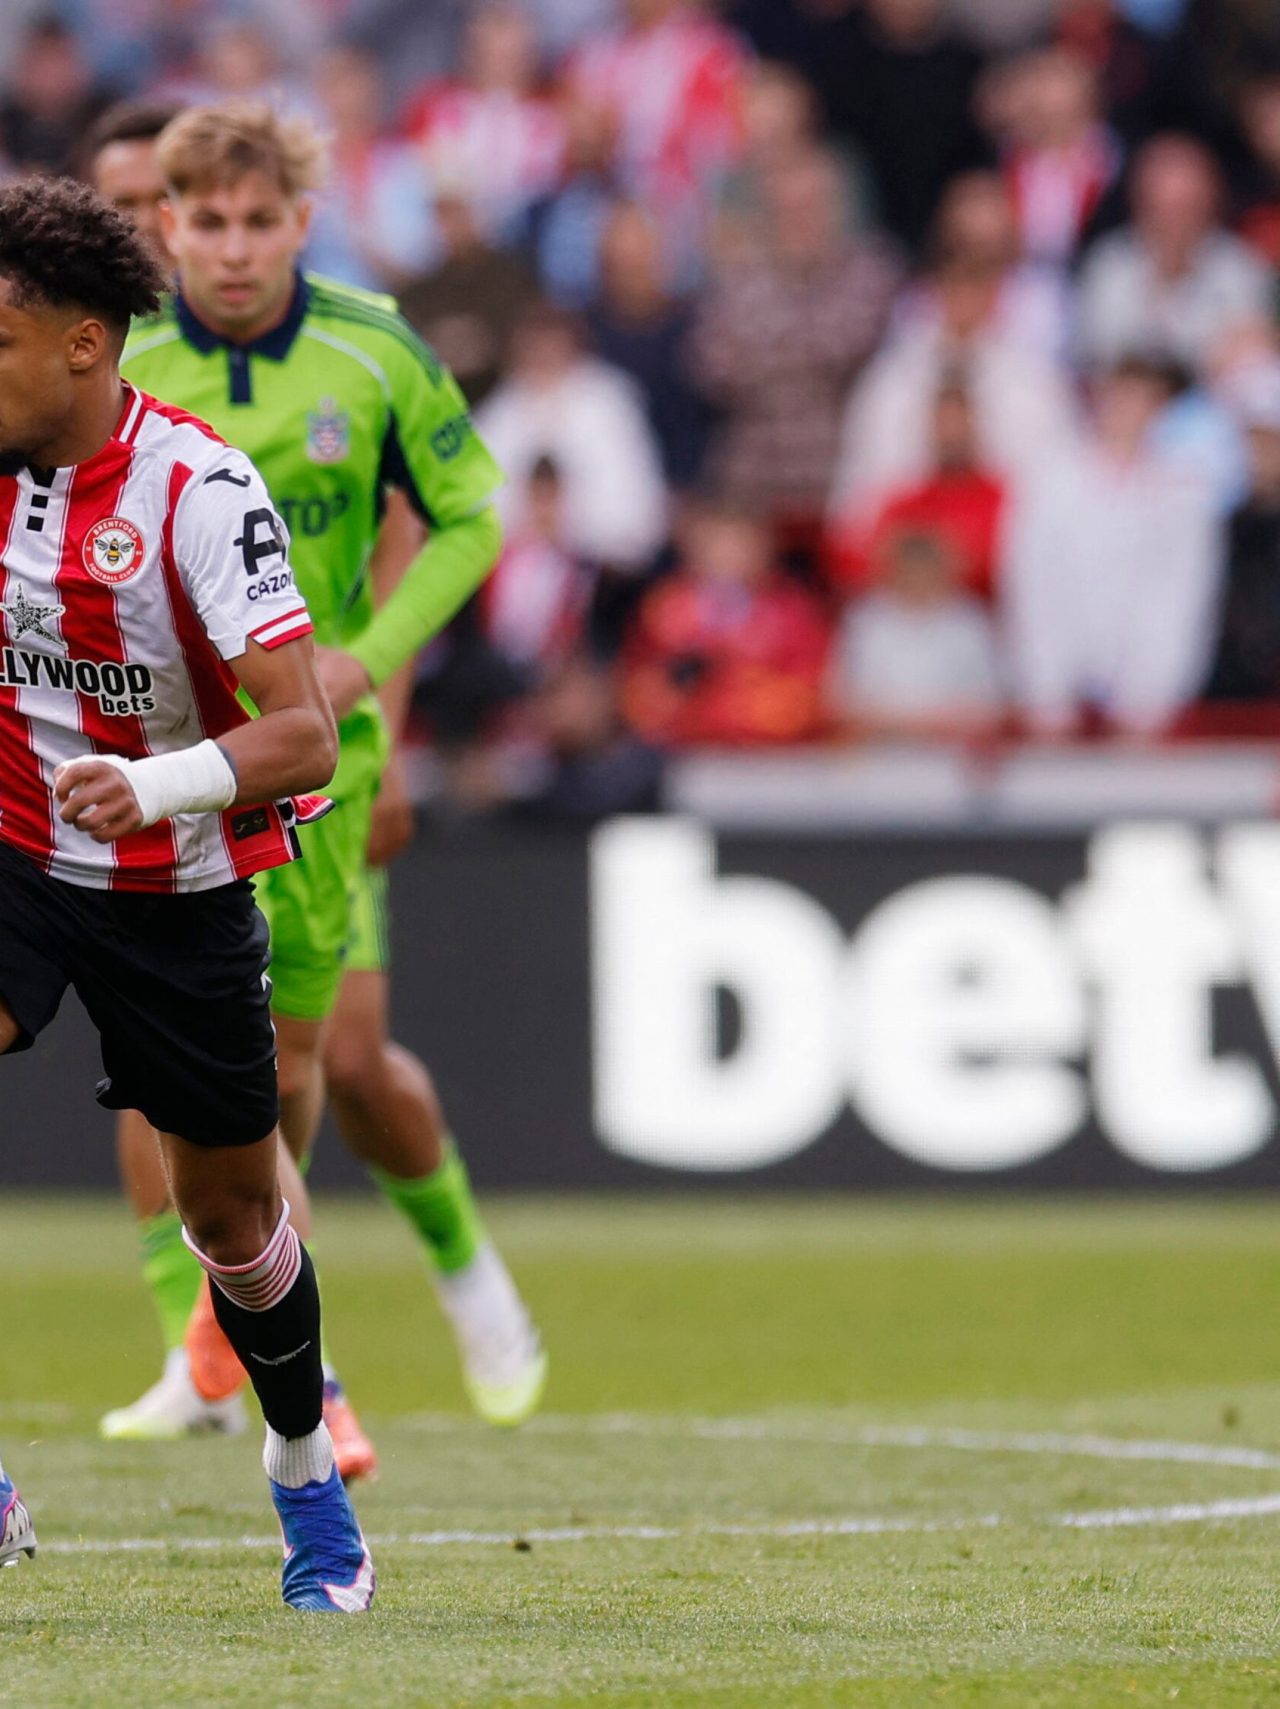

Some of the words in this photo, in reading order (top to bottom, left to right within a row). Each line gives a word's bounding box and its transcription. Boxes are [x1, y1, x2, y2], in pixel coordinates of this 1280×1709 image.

[93, 520, 138, 539] BRENTFORD
[88, 562, 118, 581] FOOTBALL
[118, 566, 135, 580] CLUB
[246, 571, 292, 601] CAZO
[100, 693, 155, 714] bets
[588, 813, 1280, 1173] bet
